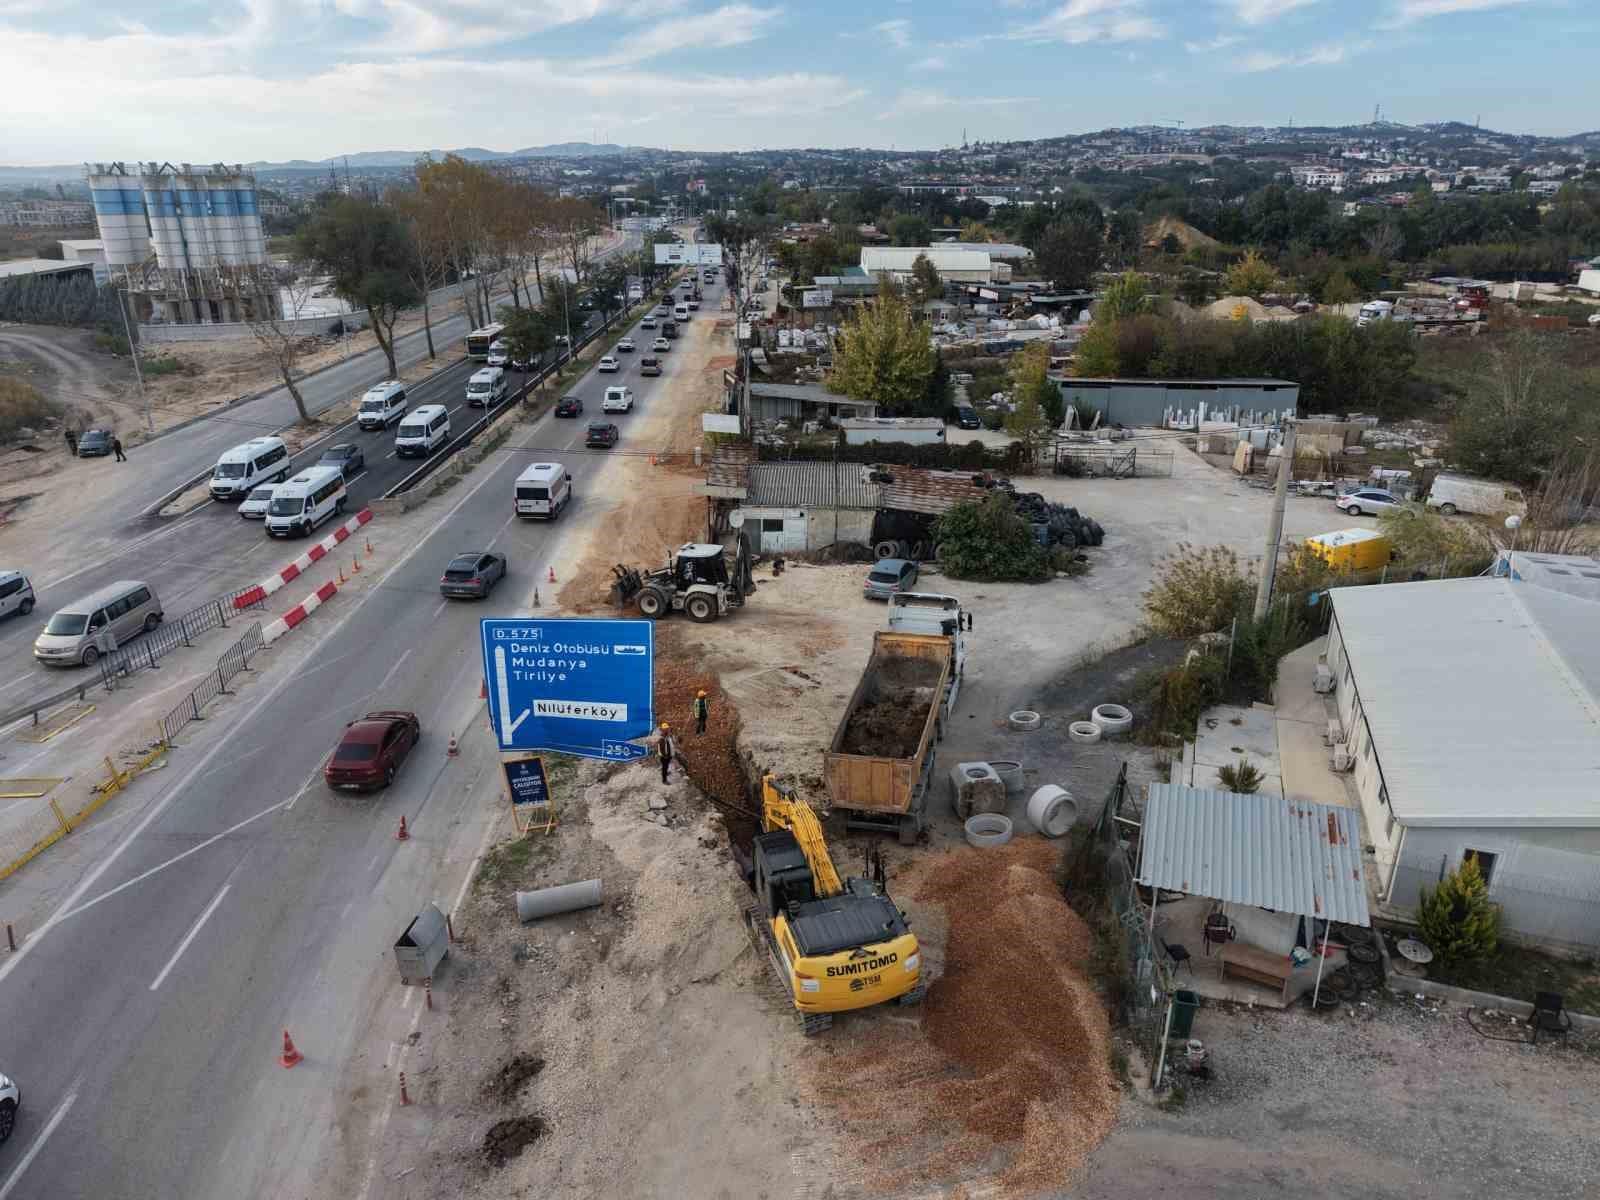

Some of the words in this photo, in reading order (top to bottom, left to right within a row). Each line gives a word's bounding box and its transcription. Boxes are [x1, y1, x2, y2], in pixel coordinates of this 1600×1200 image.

[510, 643, 550, 654] Deniz
[553, 643, 610, 655] Otobüsü
[512, 657, 587, 670] Mudanya
[513, 670, 567, 683] Tirilye
[537, 703, 618, 720] Nilüferköy
[826, 952, 898, 977] SUMITOMO
